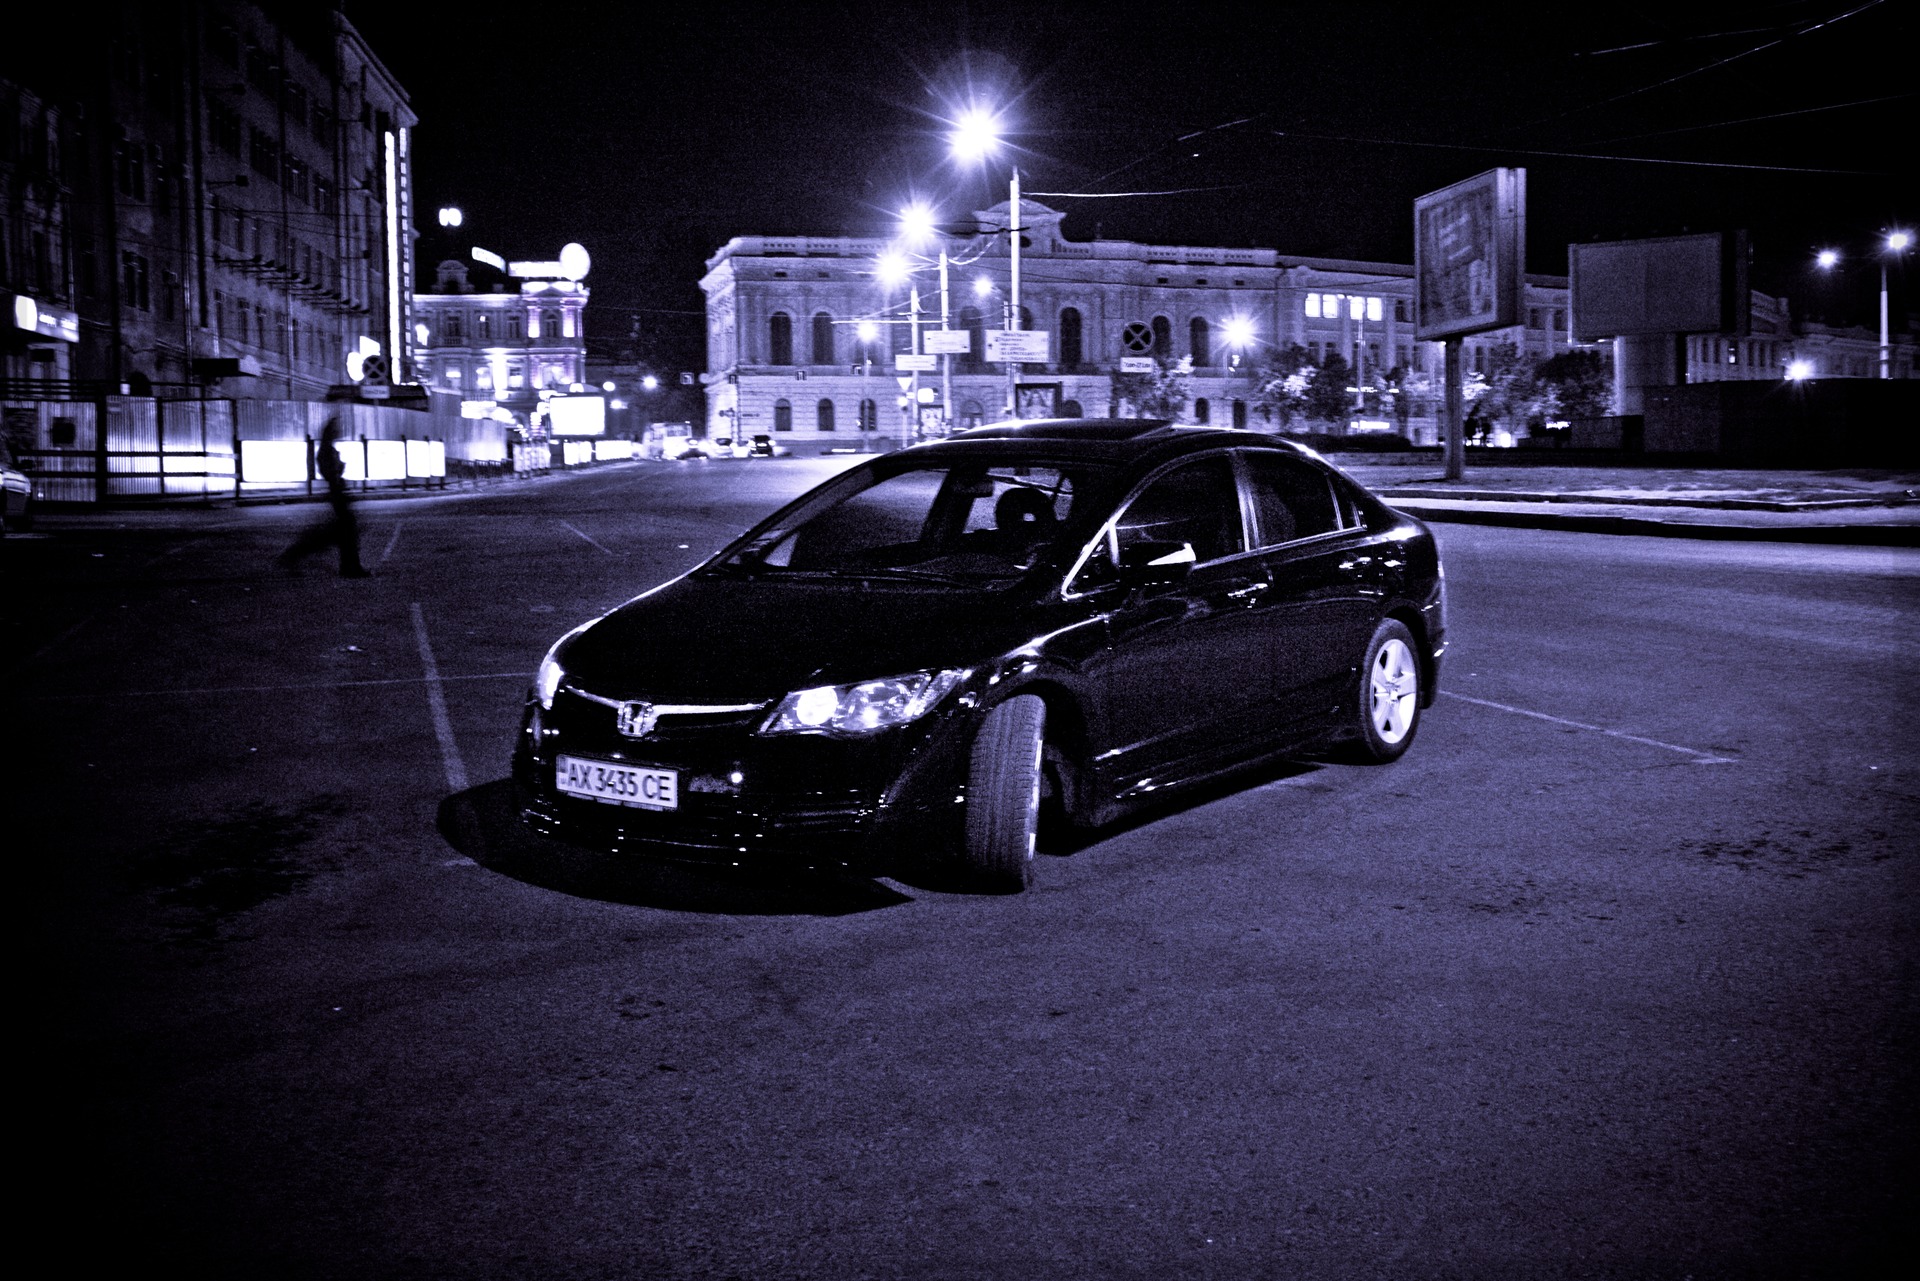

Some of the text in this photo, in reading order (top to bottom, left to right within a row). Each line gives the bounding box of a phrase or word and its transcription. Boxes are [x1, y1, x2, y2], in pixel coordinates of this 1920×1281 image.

[567, 762, 671, 802] AX 3435 CE
